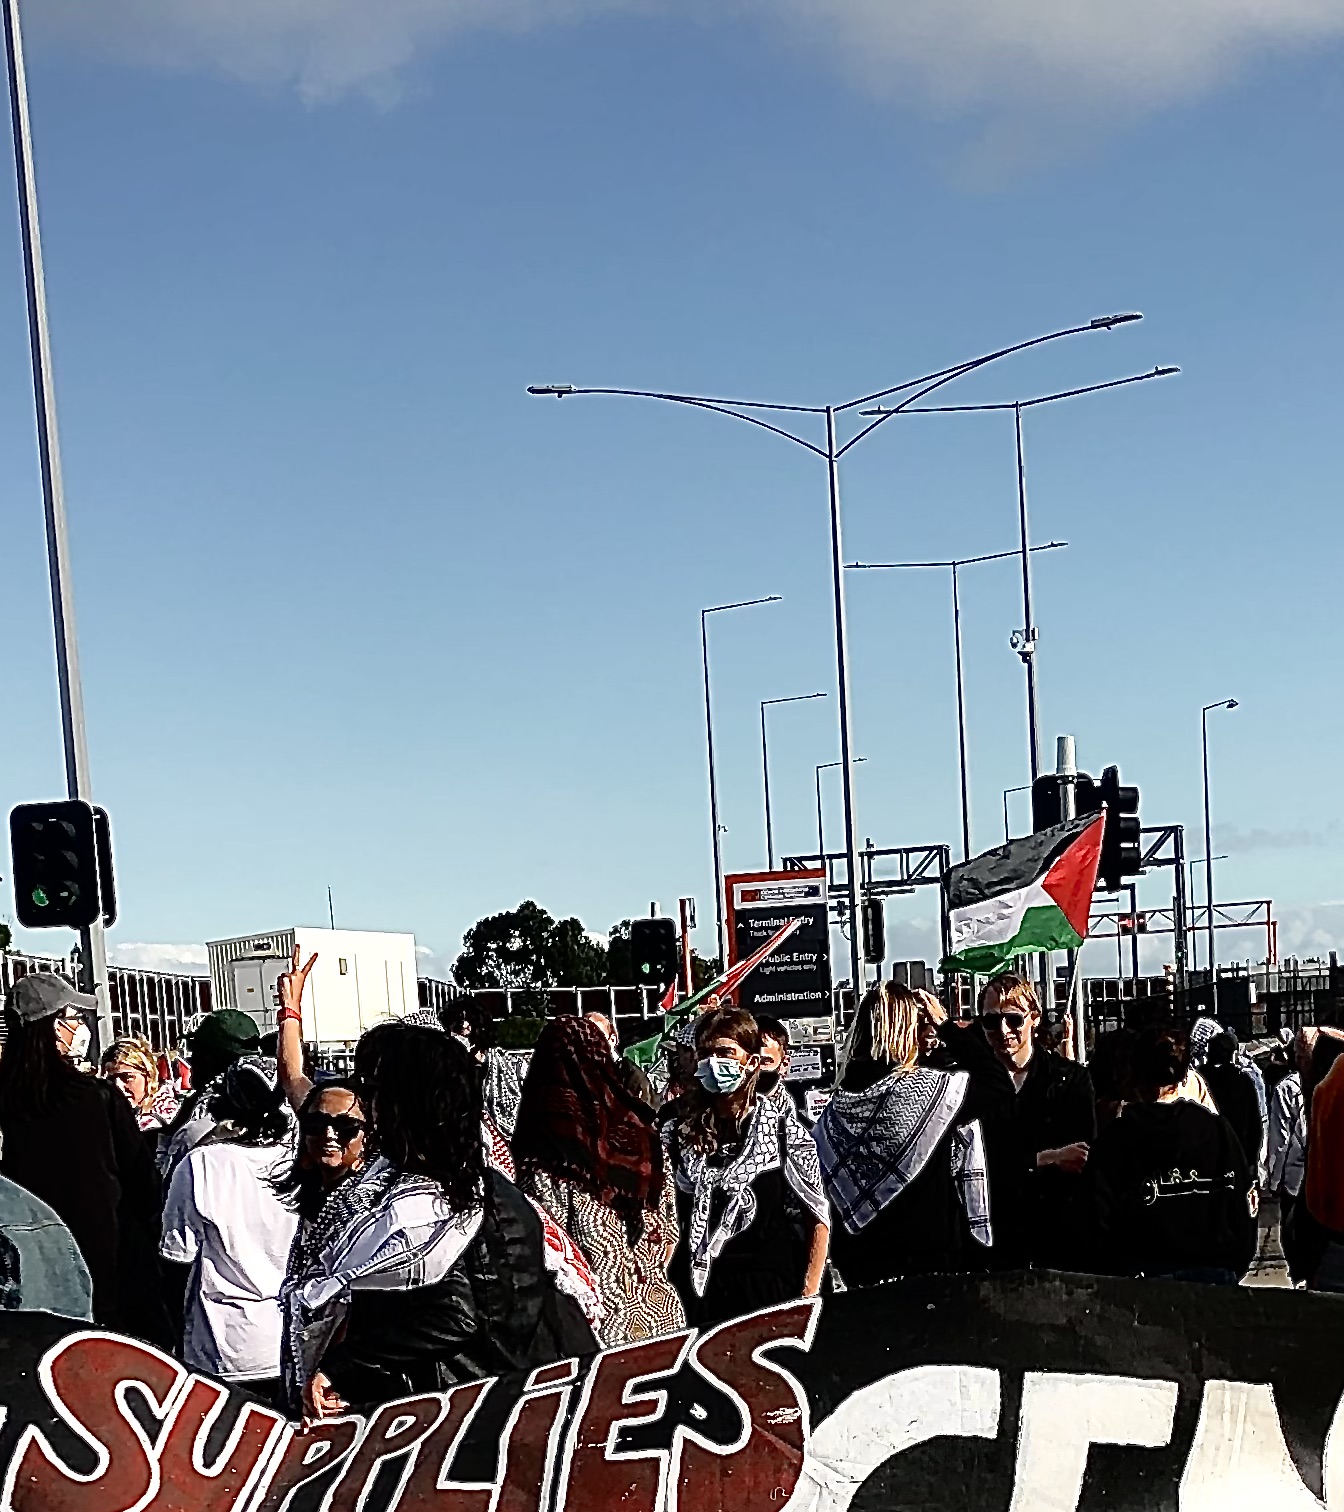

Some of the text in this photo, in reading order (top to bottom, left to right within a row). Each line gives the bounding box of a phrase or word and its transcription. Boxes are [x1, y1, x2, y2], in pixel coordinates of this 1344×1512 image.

[749, 917, 788, 928] Terminal
[762, 952, 818, 963] Public Entry
[754, 991, 822, 1003] Administration
